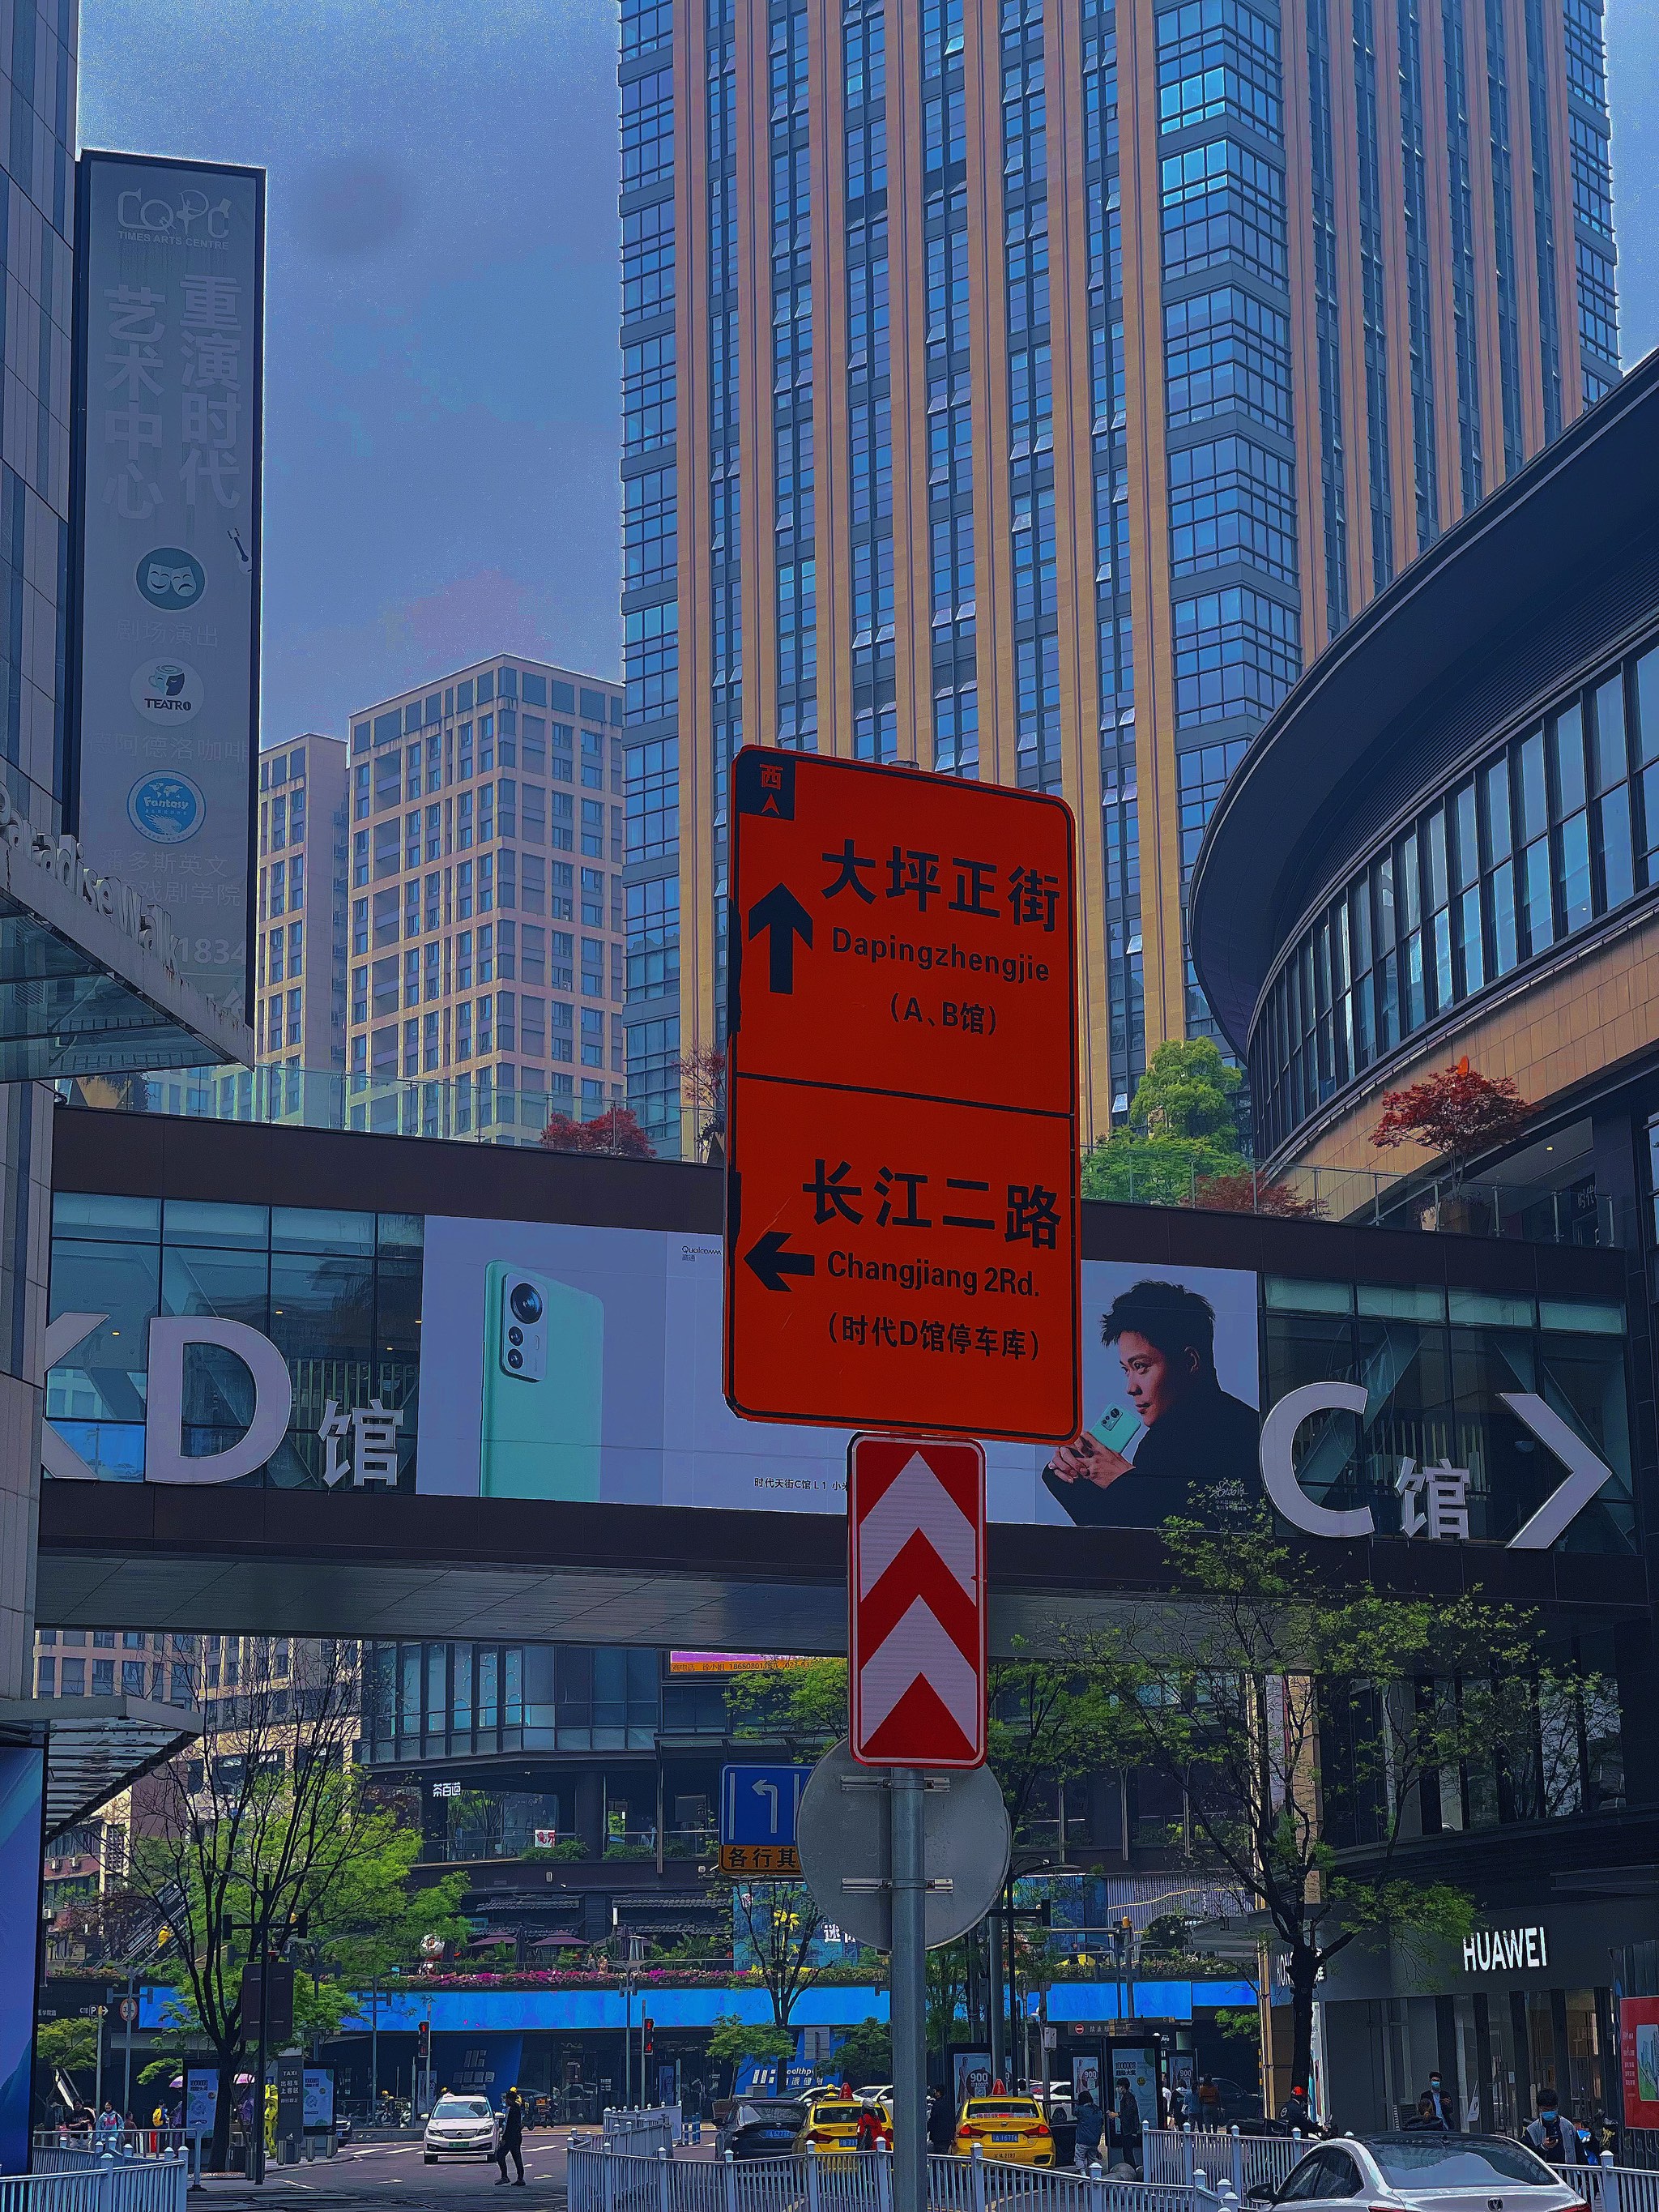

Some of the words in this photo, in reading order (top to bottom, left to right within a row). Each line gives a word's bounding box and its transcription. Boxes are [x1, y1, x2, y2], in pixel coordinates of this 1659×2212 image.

[117, 230, 151, 243] TIMES
[153, 233, 183, 247] ARTS
[185, 237, 229, 250] CENTRE
[102, 284, 166, 520] 艺术中心
[116, 618, 219, 648] 剧场演出
[144, 697, 192, 712] TEATRO
[758, 762, 783, 790] 西
[143, 796, 190, 809] Fantasy
[820, 838, 1060, 932] 大坪正街
[831, 926, 1051, 984] Dapingzhengjie
[802, 1158, 1062, 1250] 长江二路
[827, 1250, 978, 1296] Changjiang
[433, 1782, 461, 1798] 茶百道
[729, 1847, 796, 1868] 各行其
[1462, 1926, 1547, 1971] HUAWEI
[970, 2073, 988, 2082] 900
